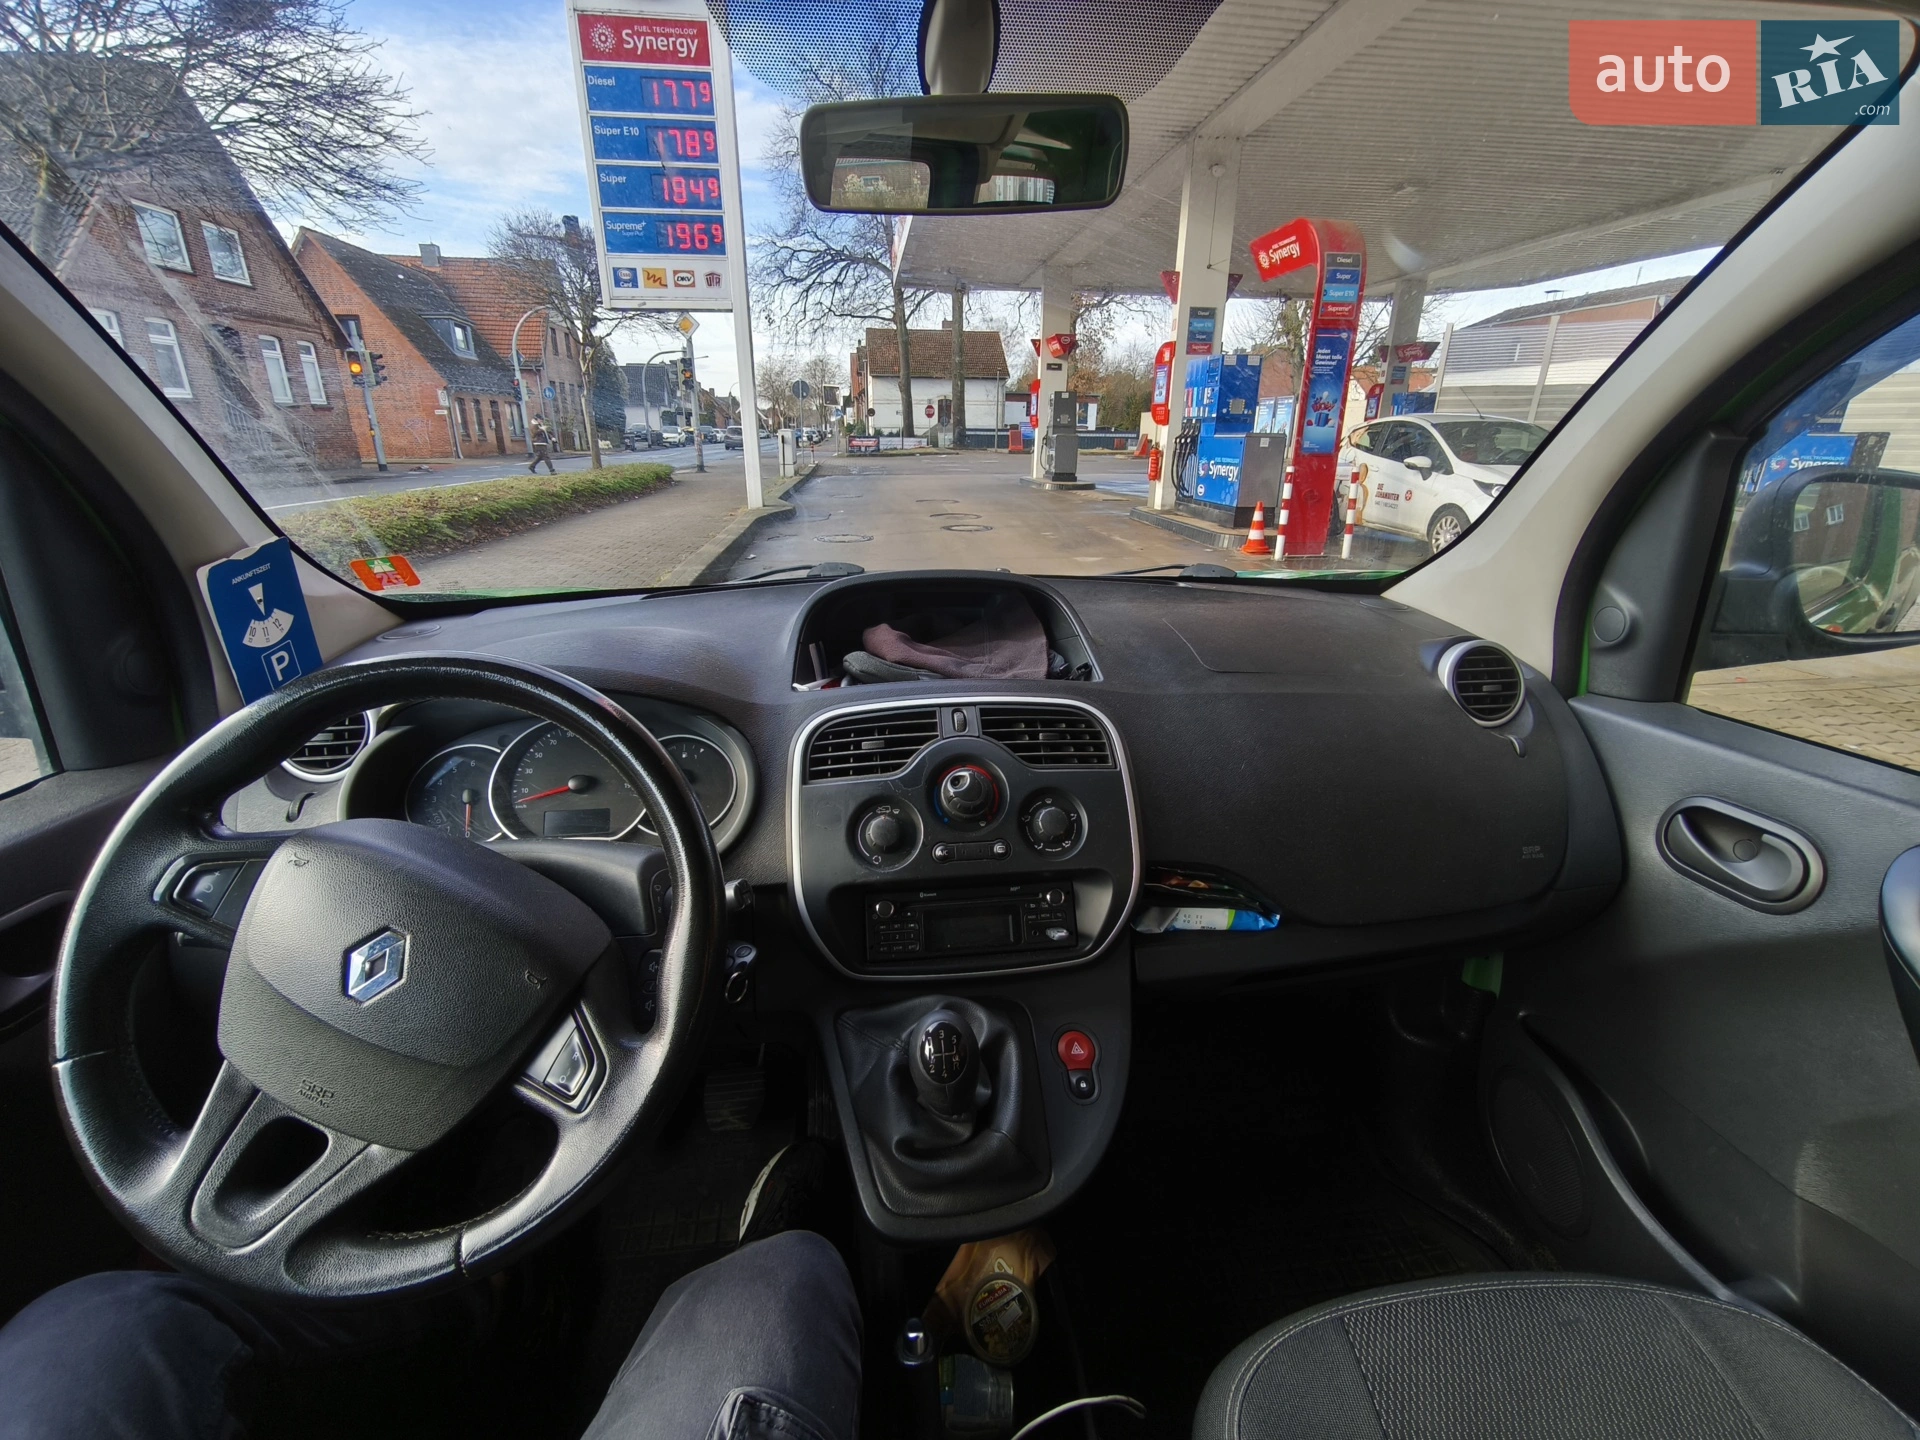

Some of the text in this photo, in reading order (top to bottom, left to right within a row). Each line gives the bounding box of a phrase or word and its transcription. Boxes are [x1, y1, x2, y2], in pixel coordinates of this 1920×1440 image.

[652, 26, 698, 35] TECHNOLOGY
[622, 29, 698, 58] Synergy
[587, 75, 616, 86] Diesel
[652, 80, 712, 108] 1779
[594, 125, 640, 136] Super E10
[658, 129, 715, 158] 1789
[600, 174, 626, 184] Super
[662, 176, 720, 205] 1849
[667, 223, 724, 250] 1969
[1268, 242, 1300, 264] Synergy
[1336, 272, 1352, 280] Super
[1329, 290, 1344, 298] Super
[1209, 460, 1239, 482] Synergy
[232, 562, 271, 585] ANKUNFTSZEIT
[272, 618, 282, 629] 12
[249, 626, 256, 637] 10
[262, 626, 269, 637] 11
[271, 650, 290, 682] P
[938, 1030, 944, 1039] 3
[952, 1035, 957, 1044] 5
[930, 1064, 935, 1074] 2
[942, 1070, 947, 1078] 4
